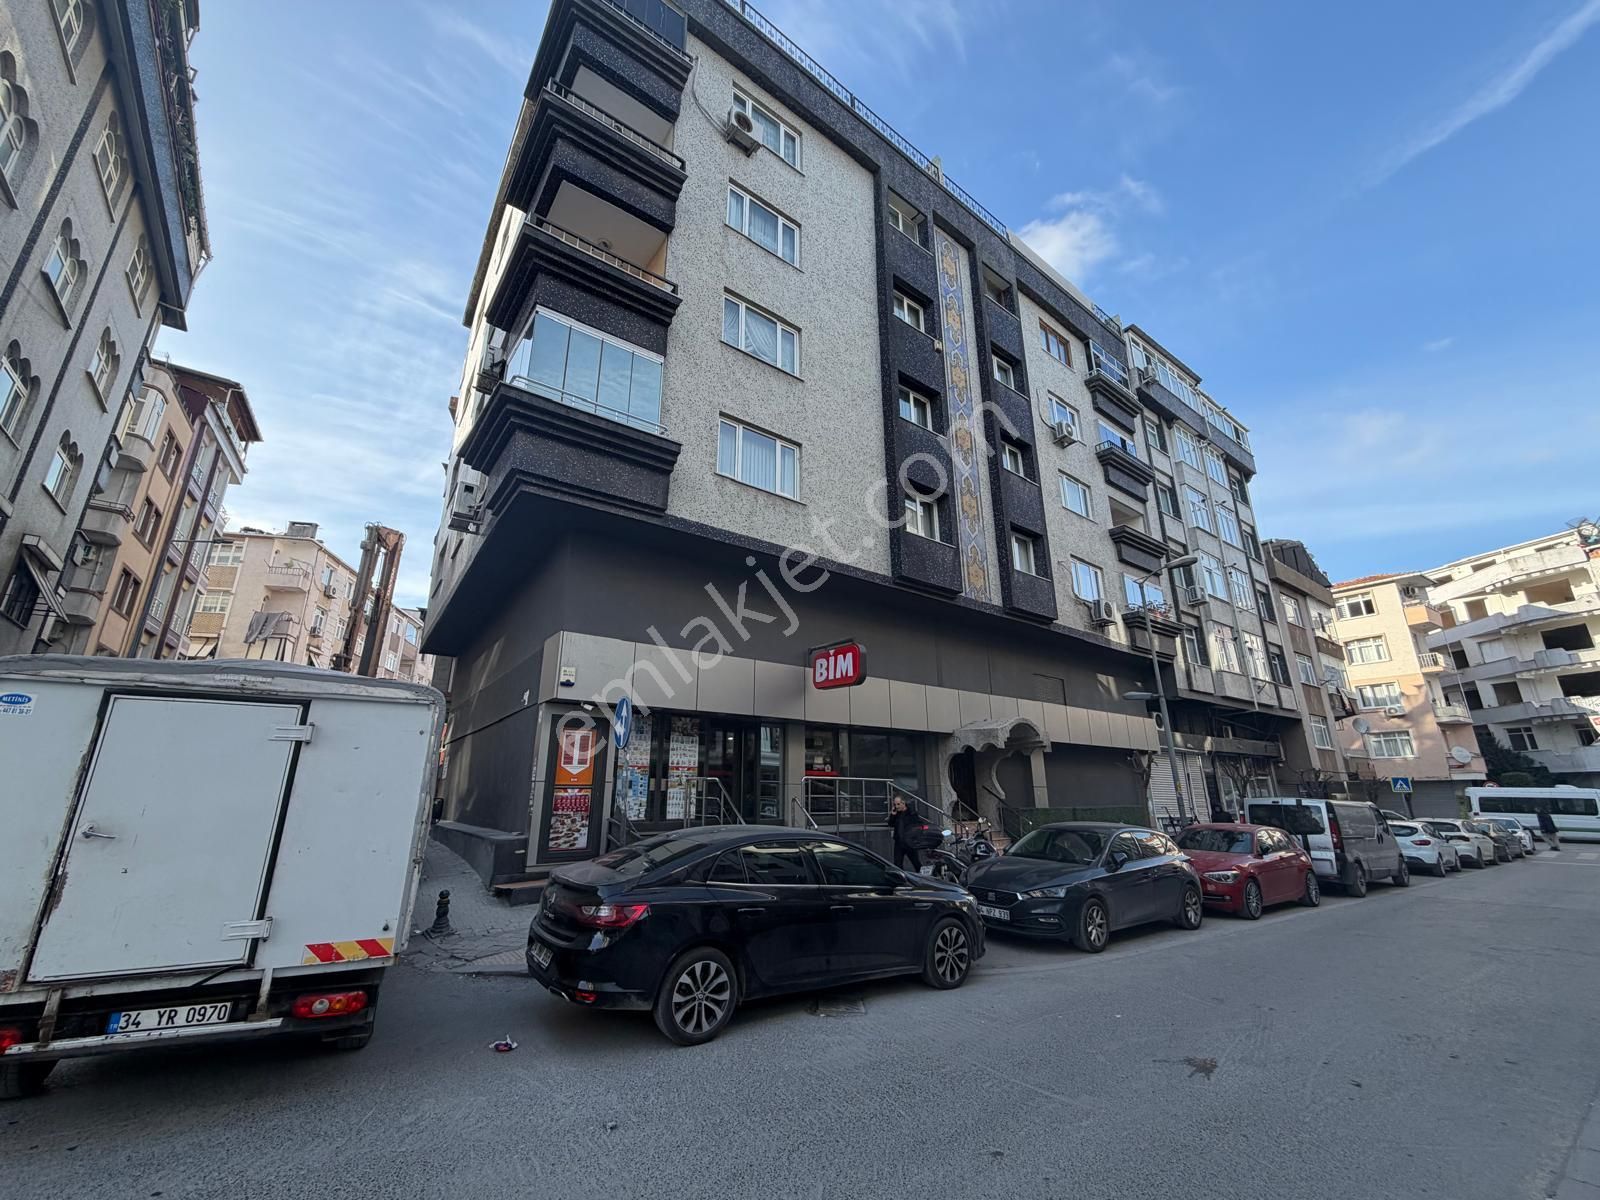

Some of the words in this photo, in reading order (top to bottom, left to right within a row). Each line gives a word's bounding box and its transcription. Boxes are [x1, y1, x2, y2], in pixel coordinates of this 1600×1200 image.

[815, 649, 854, 683] BİM
[119, 1012, 142, 1030] 34
[156, 1009, 178, 1027] YR
[185, 1004, 229, 1024] 0970
